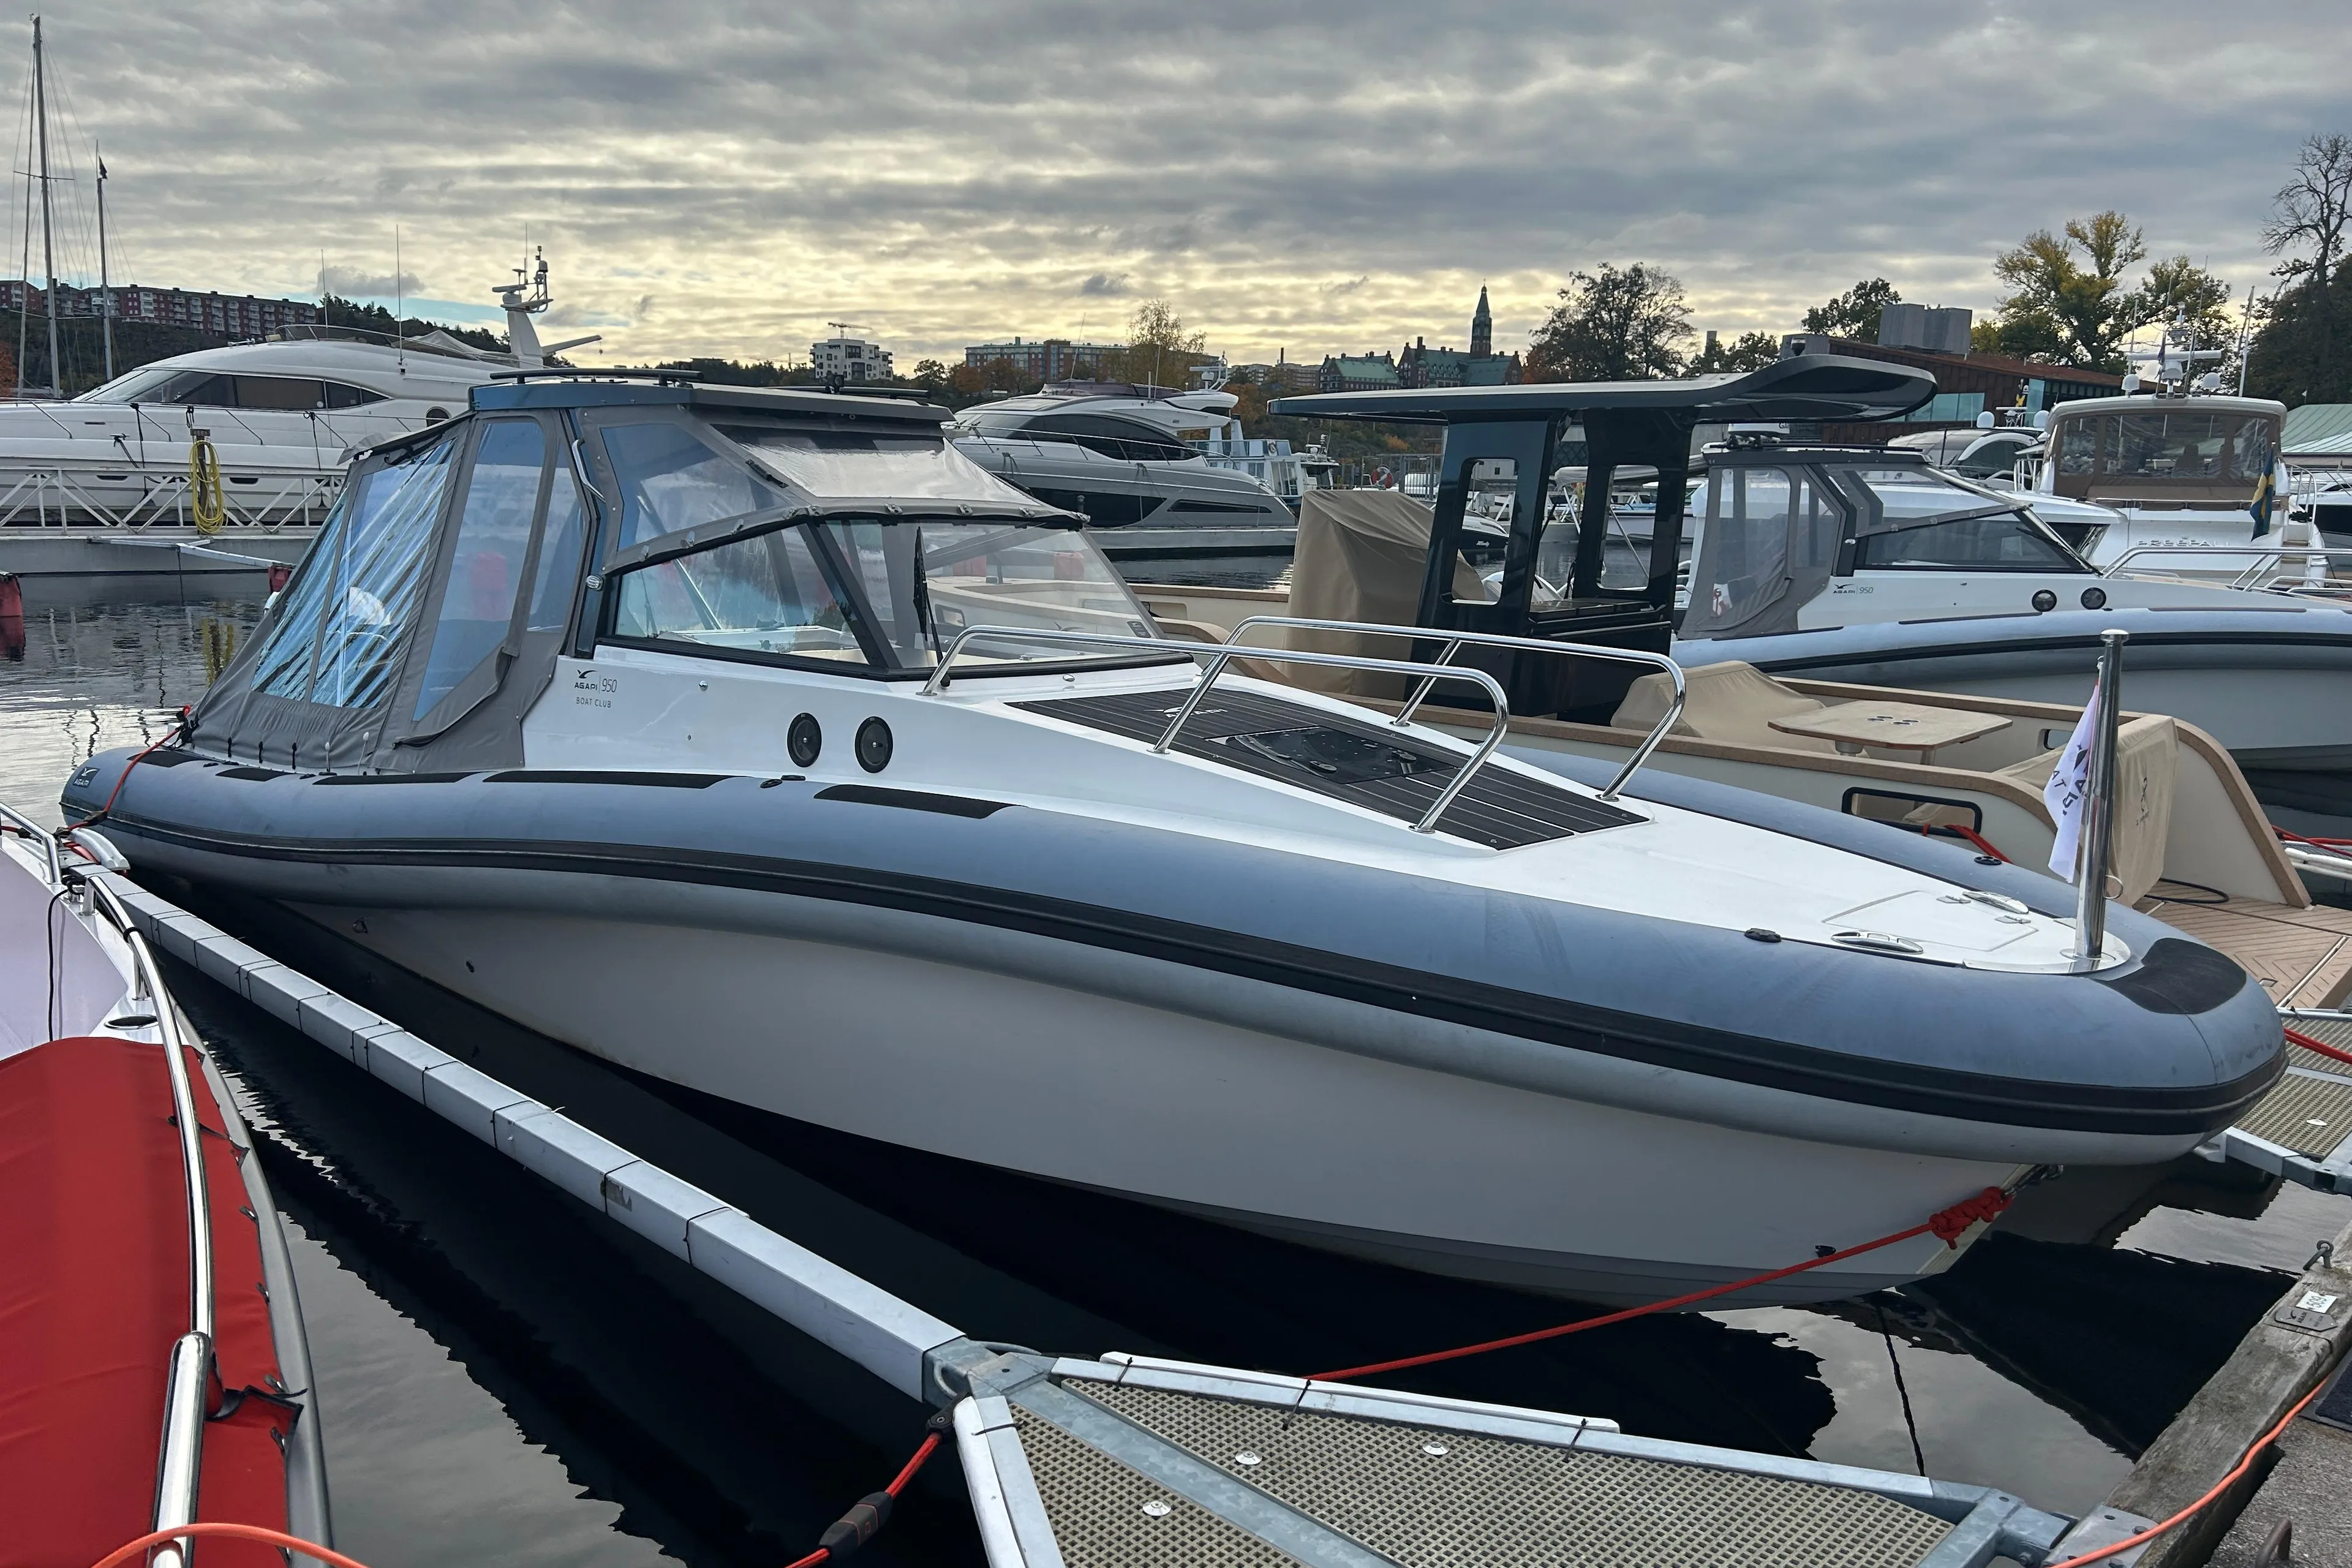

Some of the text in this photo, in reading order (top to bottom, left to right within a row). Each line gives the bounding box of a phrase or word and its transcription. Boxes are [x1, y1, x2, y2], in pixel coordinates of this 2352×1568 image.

[575, 678, 617, 693] AGAPI 950
[576, 696, 611, 708] BOAT CLUB
[1165, 709, 1229, 718] AAPI
